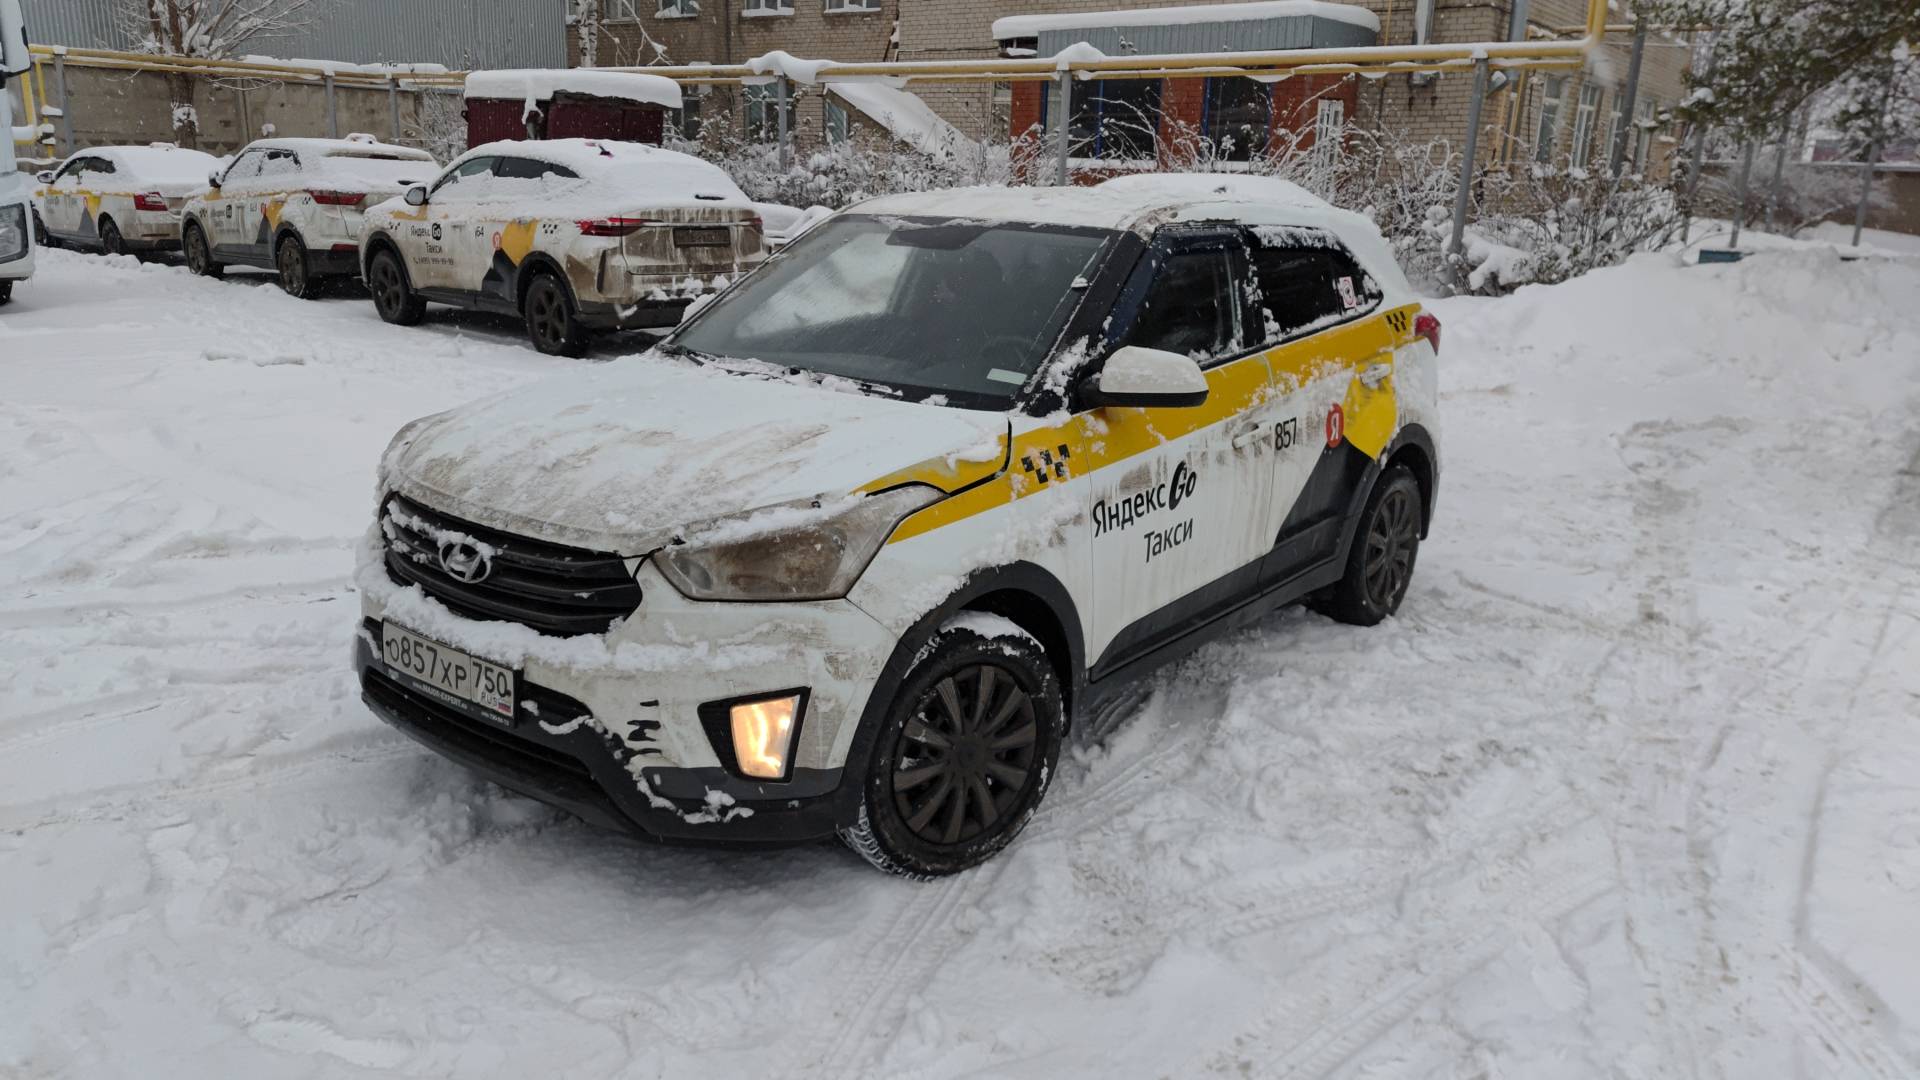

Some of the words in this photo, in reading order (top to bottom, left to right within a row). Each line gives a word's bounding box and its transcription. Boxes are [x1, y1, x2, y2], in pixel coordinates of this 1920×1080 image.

[1275, 417, 1297, 451] 857
[1329, 412, 1341, 441] Я
[1092, 483, 1167, 538] Яндекс
[1168, 460, 1198, 510] Go
[1143, 518, 1194, 563] Такси
